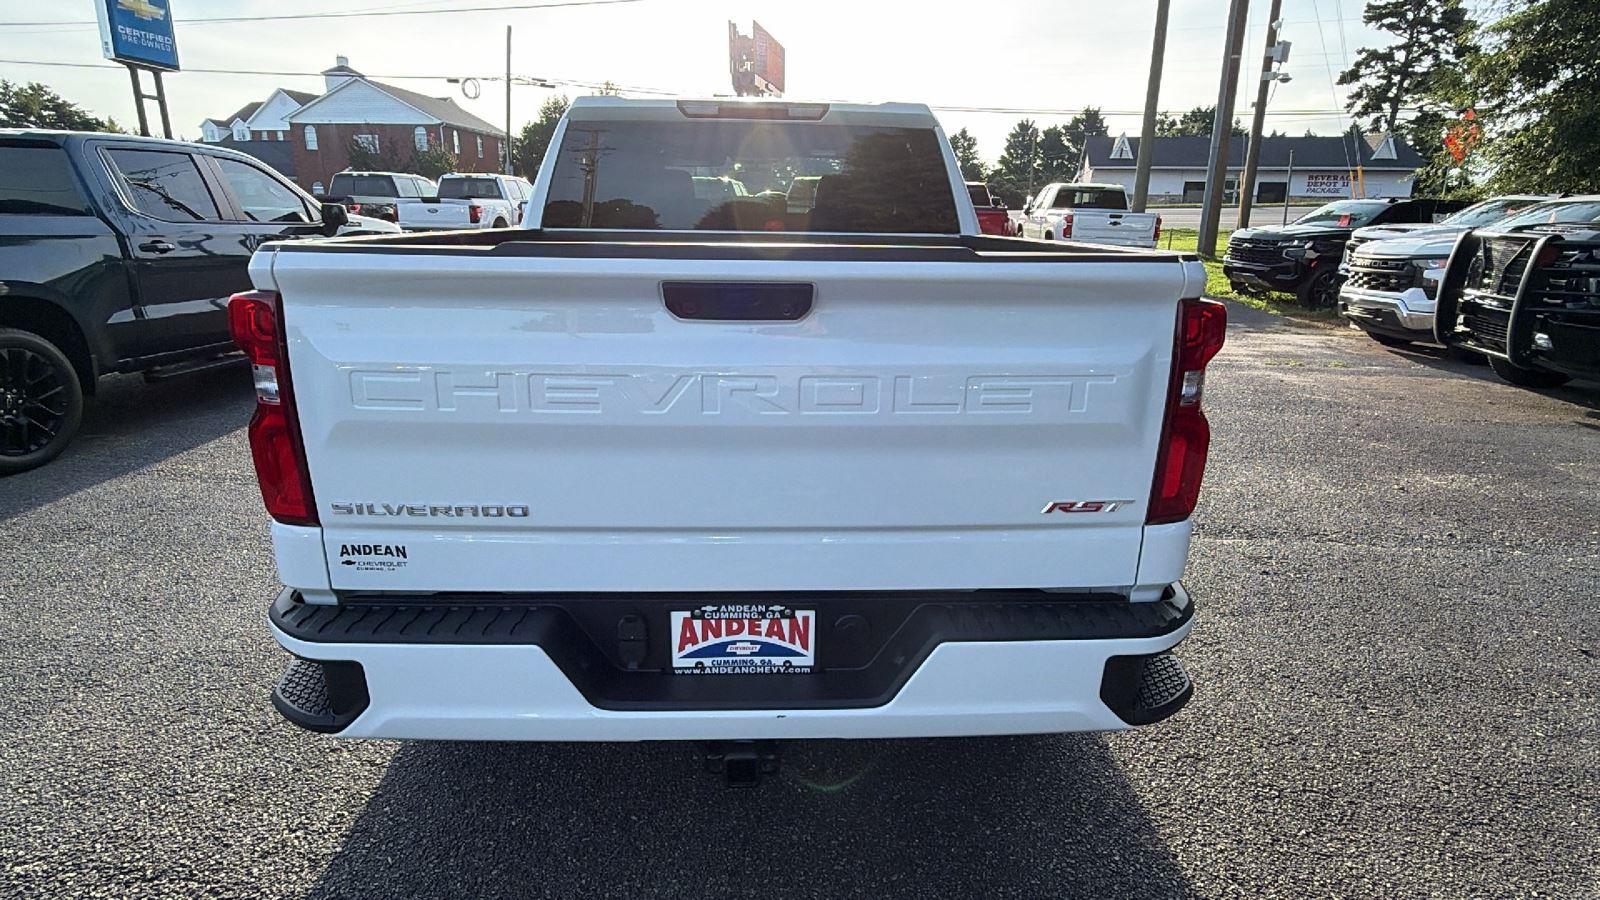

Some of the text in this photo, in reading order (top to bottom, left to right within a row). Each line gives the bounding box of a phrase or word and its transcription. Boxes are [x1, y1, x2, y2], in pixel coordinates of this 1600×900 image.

[118, 25, 172, 44] CERTIFIED
[122, 34, 171, 52] PRE-OWNED
[349, 369, 1117, 414] CHEVROLET
[331, 501, 530, 518] SILVERADO
[1040, 499, 1136, 514] RST
[339, 544, 408, 559] ANDEAN
[704, 611, 781, 619] CUMMING, GA
[677, 615, 810, 654] ANDEAN
[674, 666, 811, 674] www.ANDEANCHEVY.com
